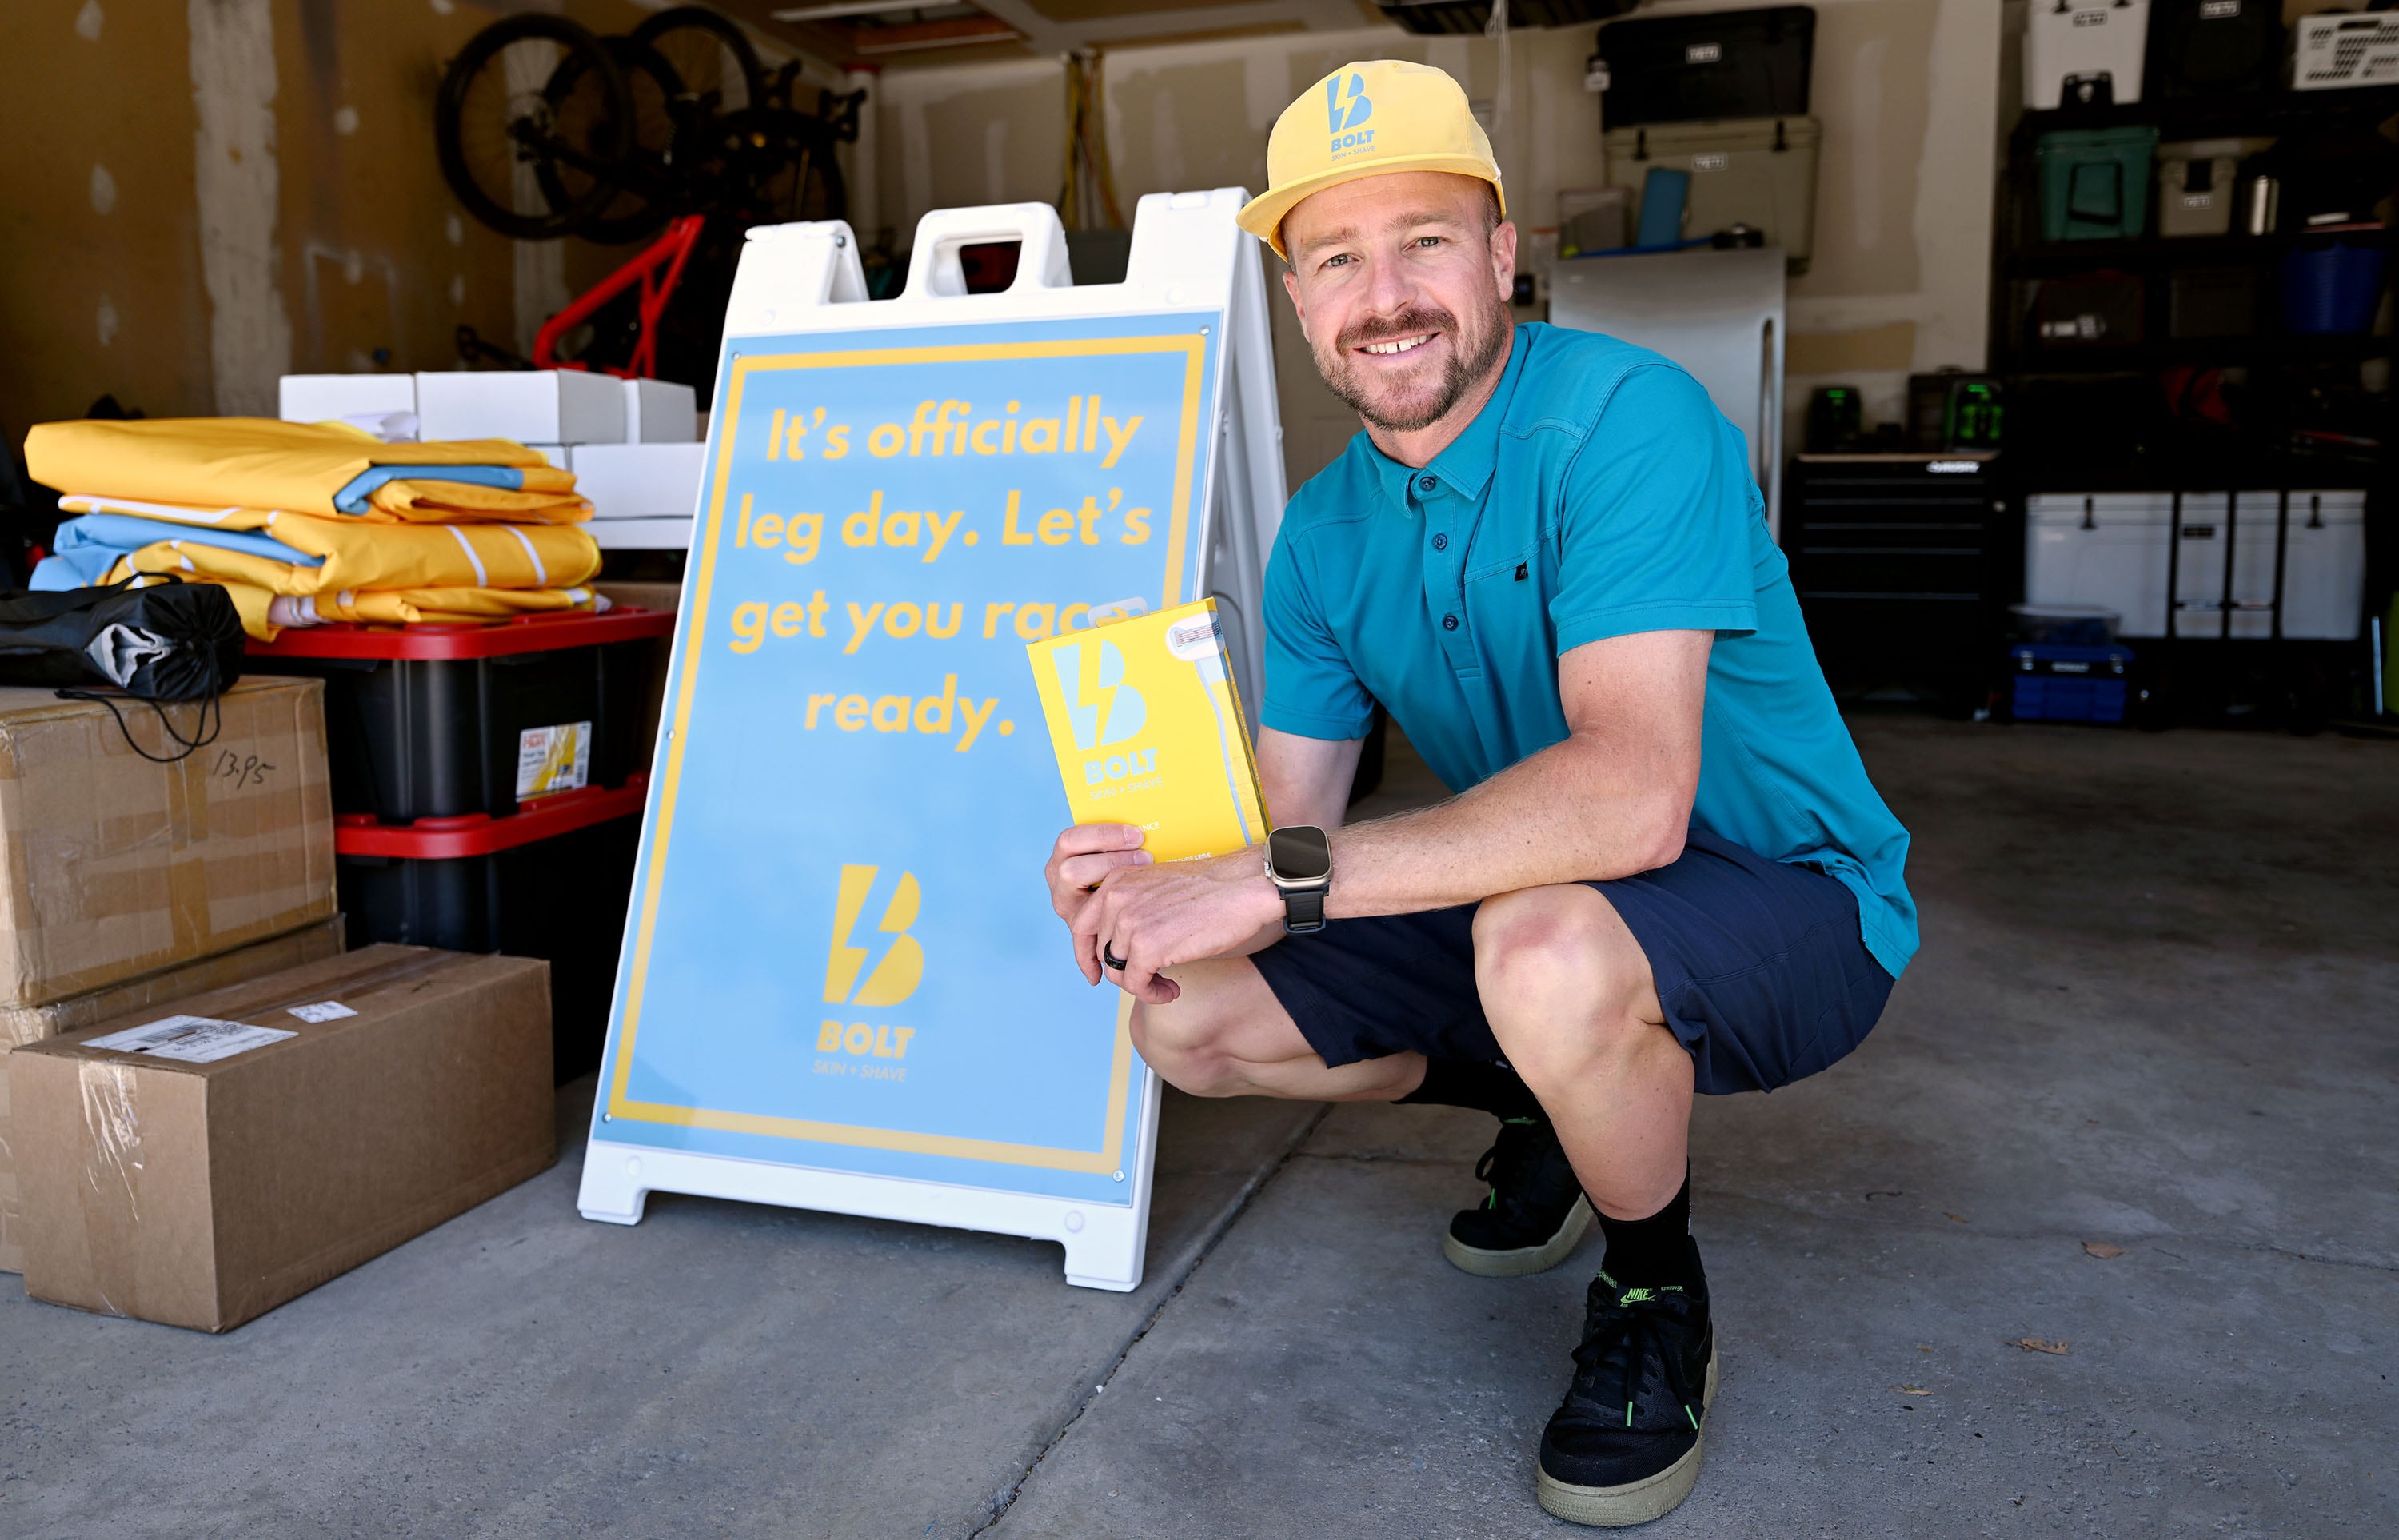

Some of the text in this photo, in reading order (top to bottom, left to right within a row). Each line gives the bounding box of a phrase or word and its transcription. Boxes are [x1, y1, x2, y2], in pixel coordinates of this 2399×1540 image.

[1331, 130, 1375, 153] BOLT
[1331, 153, 1347, 162] SKIN
[1353, 145, 1375, 155] SHAVE
[767, 395, 1144, 469] It’s officially
[735, 487, 1152, 565] leg day. Let’s
[729, 590, 829, 654] get
[844, 602, 964, 654] you
[805, 673, 1015, 752] ready.
[1084, 747, 1158, 786] BOLT
[1090, 787, 1116, 801] SKIN
[1128, 776, 1164, 792] SHAVE
[816, 1019, 915, 1059] BOLT
[812, 1059, 847, 1075] SKIN
[860, 1063, 908, 1083] SHAVE
[1627, 1288, 1649, 1300] NIKE
